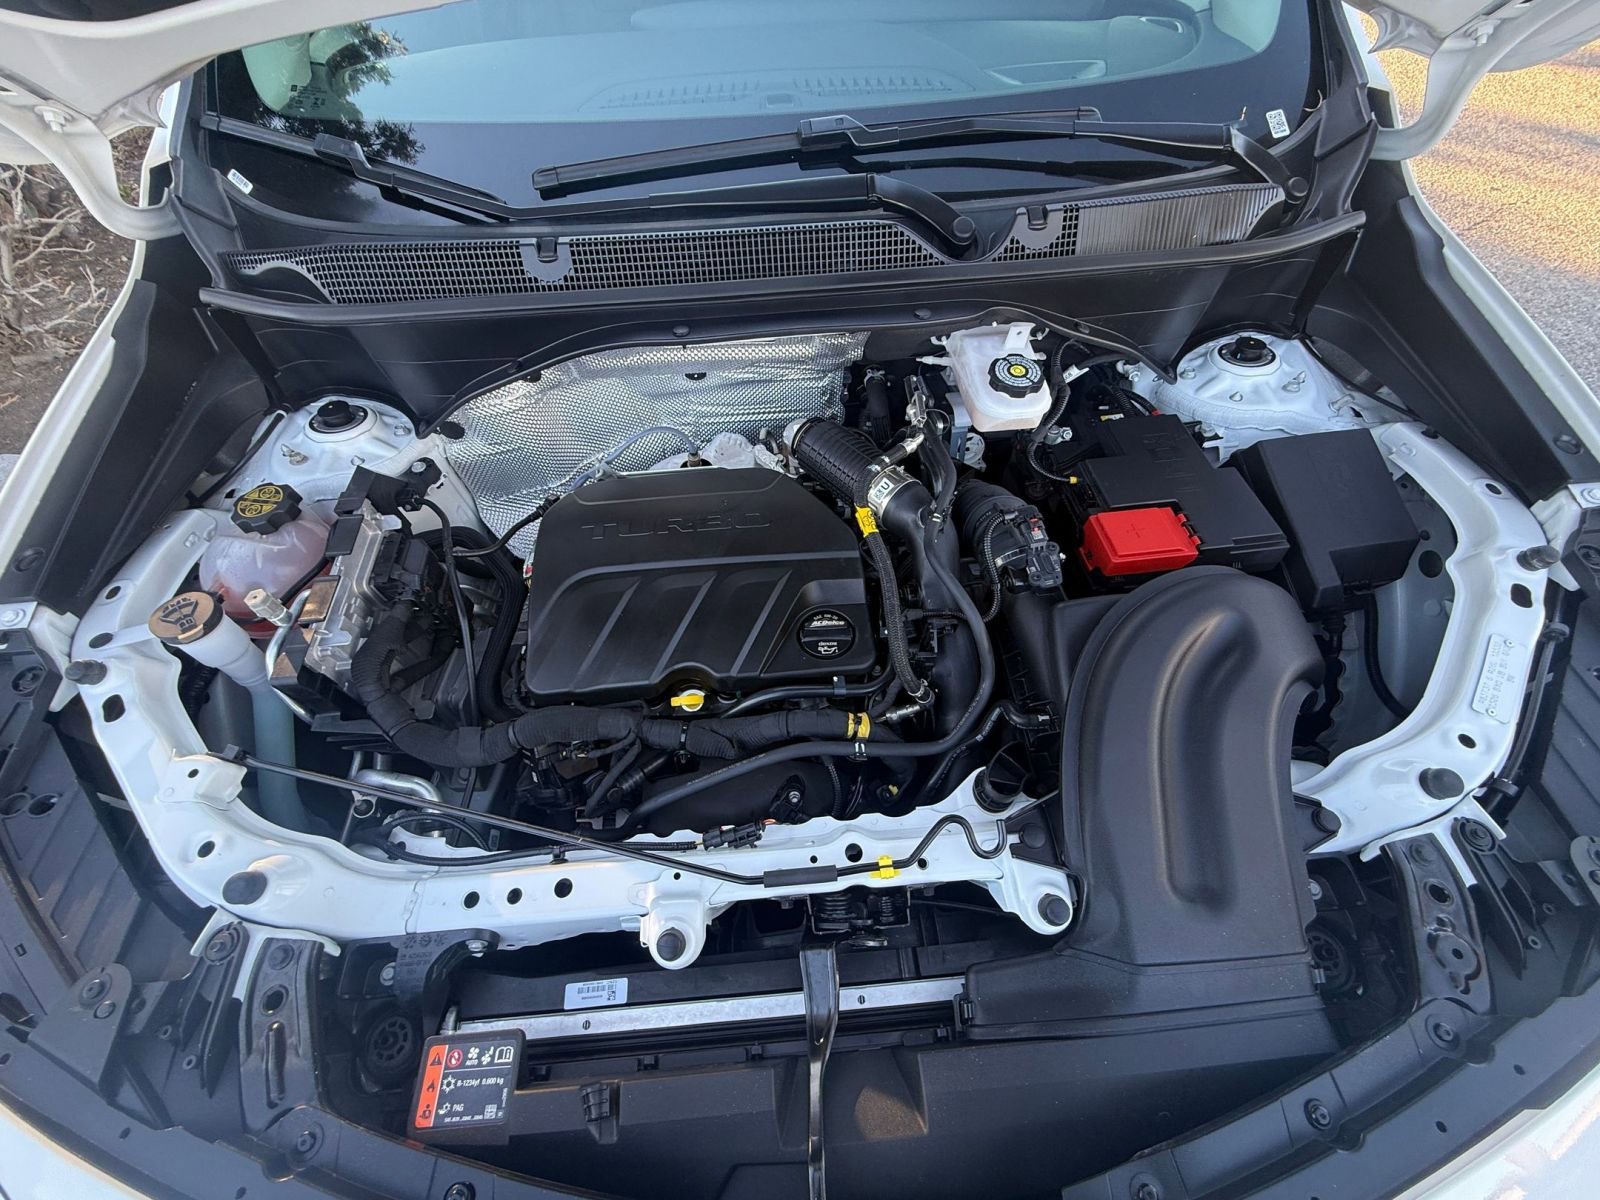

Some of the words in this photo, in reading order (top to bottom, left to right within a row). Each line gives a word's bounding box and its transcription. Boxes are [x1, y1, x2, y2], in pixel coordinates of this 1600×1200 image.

[581, 513, 770, 540] TURBO
[497, 1077, 504, 1086] kg
[452, 1103, 465, 1112] PAG
